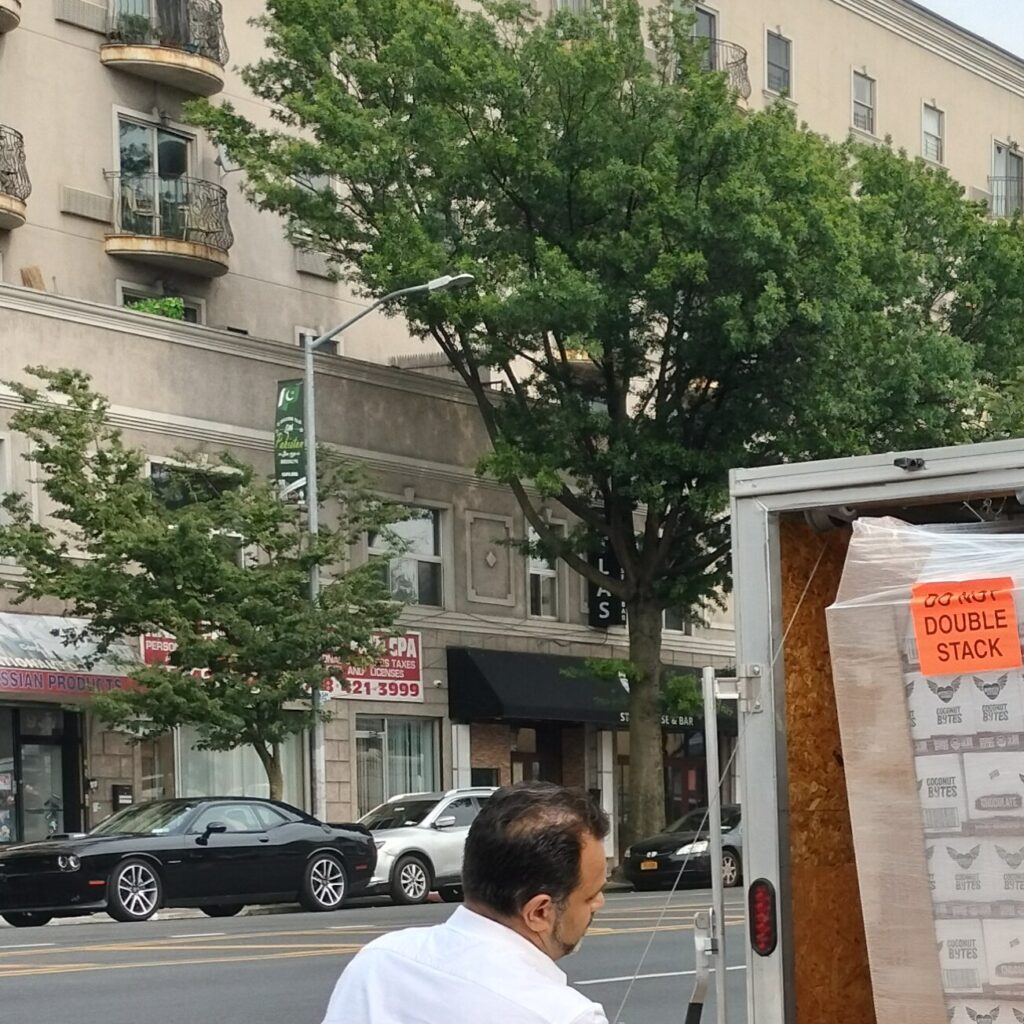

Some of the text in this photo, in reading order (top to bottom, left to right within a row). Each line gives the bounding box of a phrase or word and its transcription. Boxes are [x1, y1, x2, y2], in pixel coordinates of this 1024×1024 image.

[924, 592, 954, 608] DO
[924, 609, 1008, 635] DOUBLE
[937, 638, 1003, 662] STACK
[392, 660, 416, 670] TAXES
[370, 668, 404, 678] LICENSES
[48, 674, 122, 692] PRODUCTS
[378, 682, 419, 697] 3999
[678, 716, 694, 726] BAR
[937, 714, 962, 725] BYTES
[983, 711, 1008, 722] BYTES
[928, 786, 958, 798] BYTES
